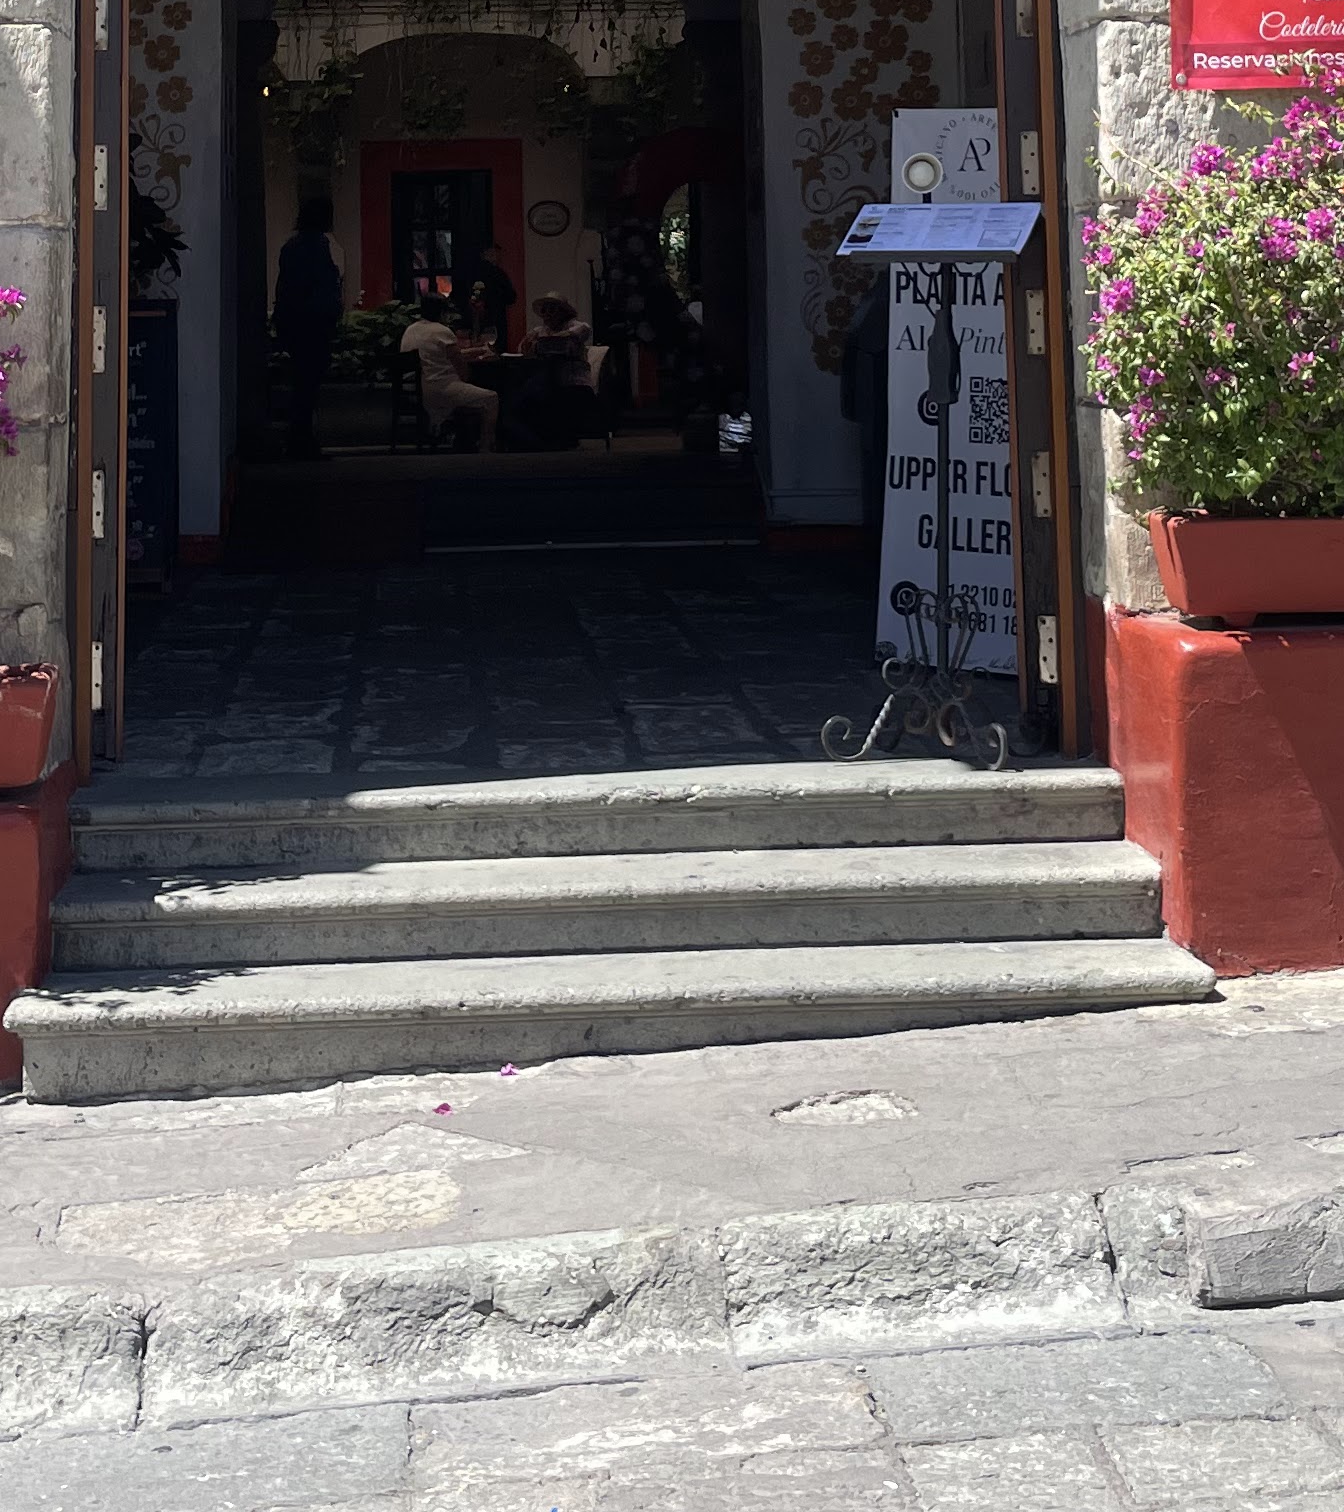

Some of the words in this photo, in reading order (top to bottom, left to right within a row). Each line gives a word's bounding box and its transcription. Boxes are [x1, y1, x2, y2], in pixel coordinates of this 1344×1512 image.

[889, 455, 967, 494] UPPR
[918, 513, 1011, 555] GLLER
[1003, 587, 1017, 608] 0
